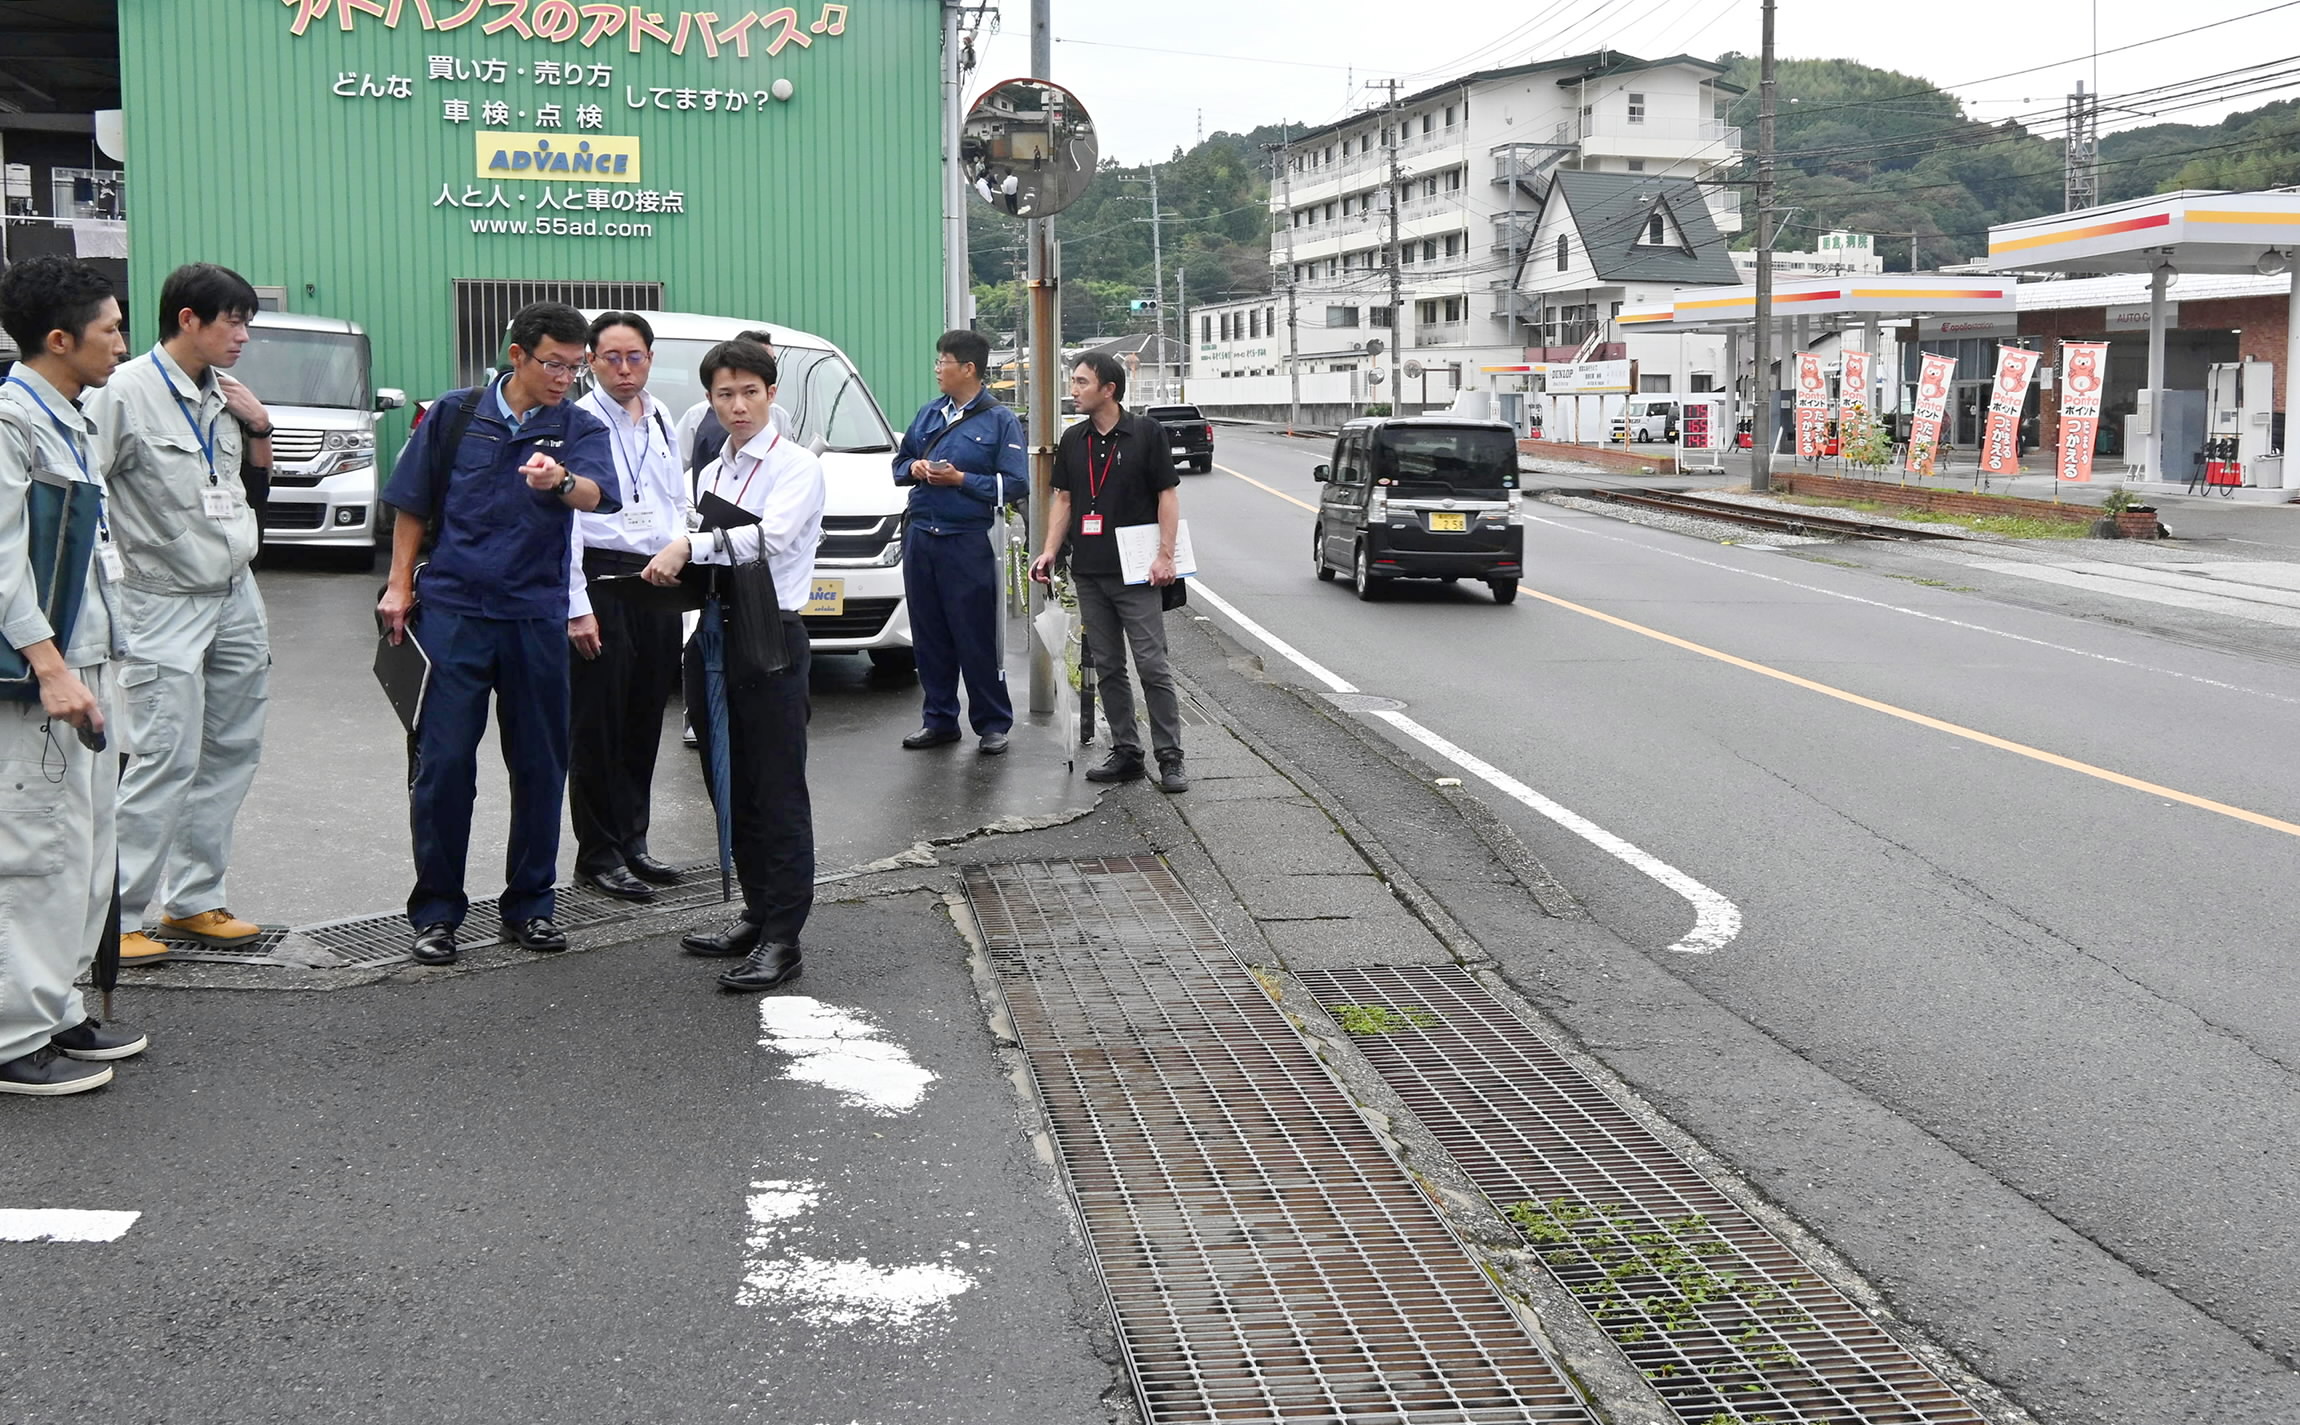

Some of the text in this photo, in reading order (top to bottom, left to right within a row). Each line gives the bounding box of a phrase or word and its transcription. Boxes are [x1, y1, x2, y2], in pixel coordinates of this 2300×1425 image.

[428, 55, 613, 88] 買い方・売り方
[332, 72, 413, 99] どんな
[626, 85, 769, 112] してますか？
[489, 139, 629, 175] ADVANCE
[433, 183, 685, 213] 人と人・人と車の接点
[470, 217, 652, 237] www.55ad.com
[2117, 312, 2141, 324] AUTO
[1798, 391, 1826, 400] Ponta
[1688, 404, 1708, 418] 175
[2065, 406, 2096, 416] ポイント
[1688, 419, 1708, 433] 165
[1801, 410, 1813, 453] つかえる
[1688, 434, 1708, 448] 143
[1989, 415, 2006, 470] つかえる
[2063, 419, 2082, 479] つかえる
